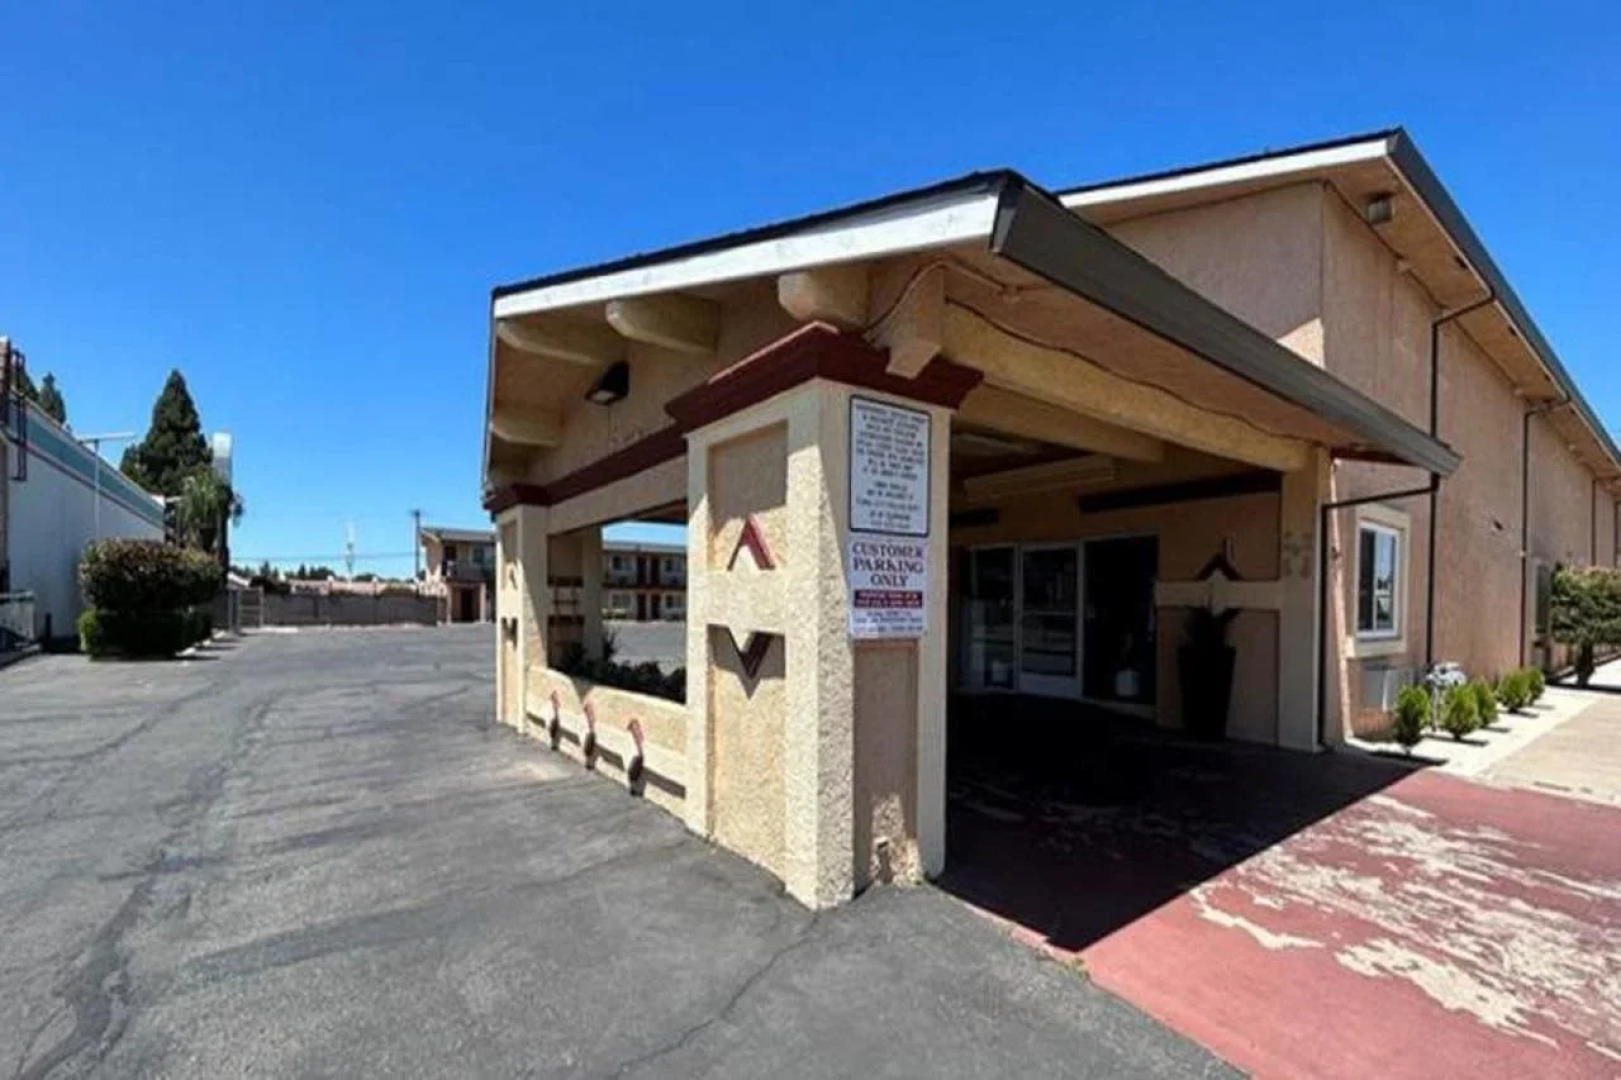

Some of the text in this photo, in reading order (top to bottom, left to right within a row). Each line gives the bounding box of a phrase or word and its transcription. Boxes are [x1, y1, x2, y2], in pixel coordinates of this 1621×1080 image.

[852, 541, 923, 558] CUSTOMER
[853, 557, 923, 573] PARKING
[870, 574, 908, 587] ONLY
